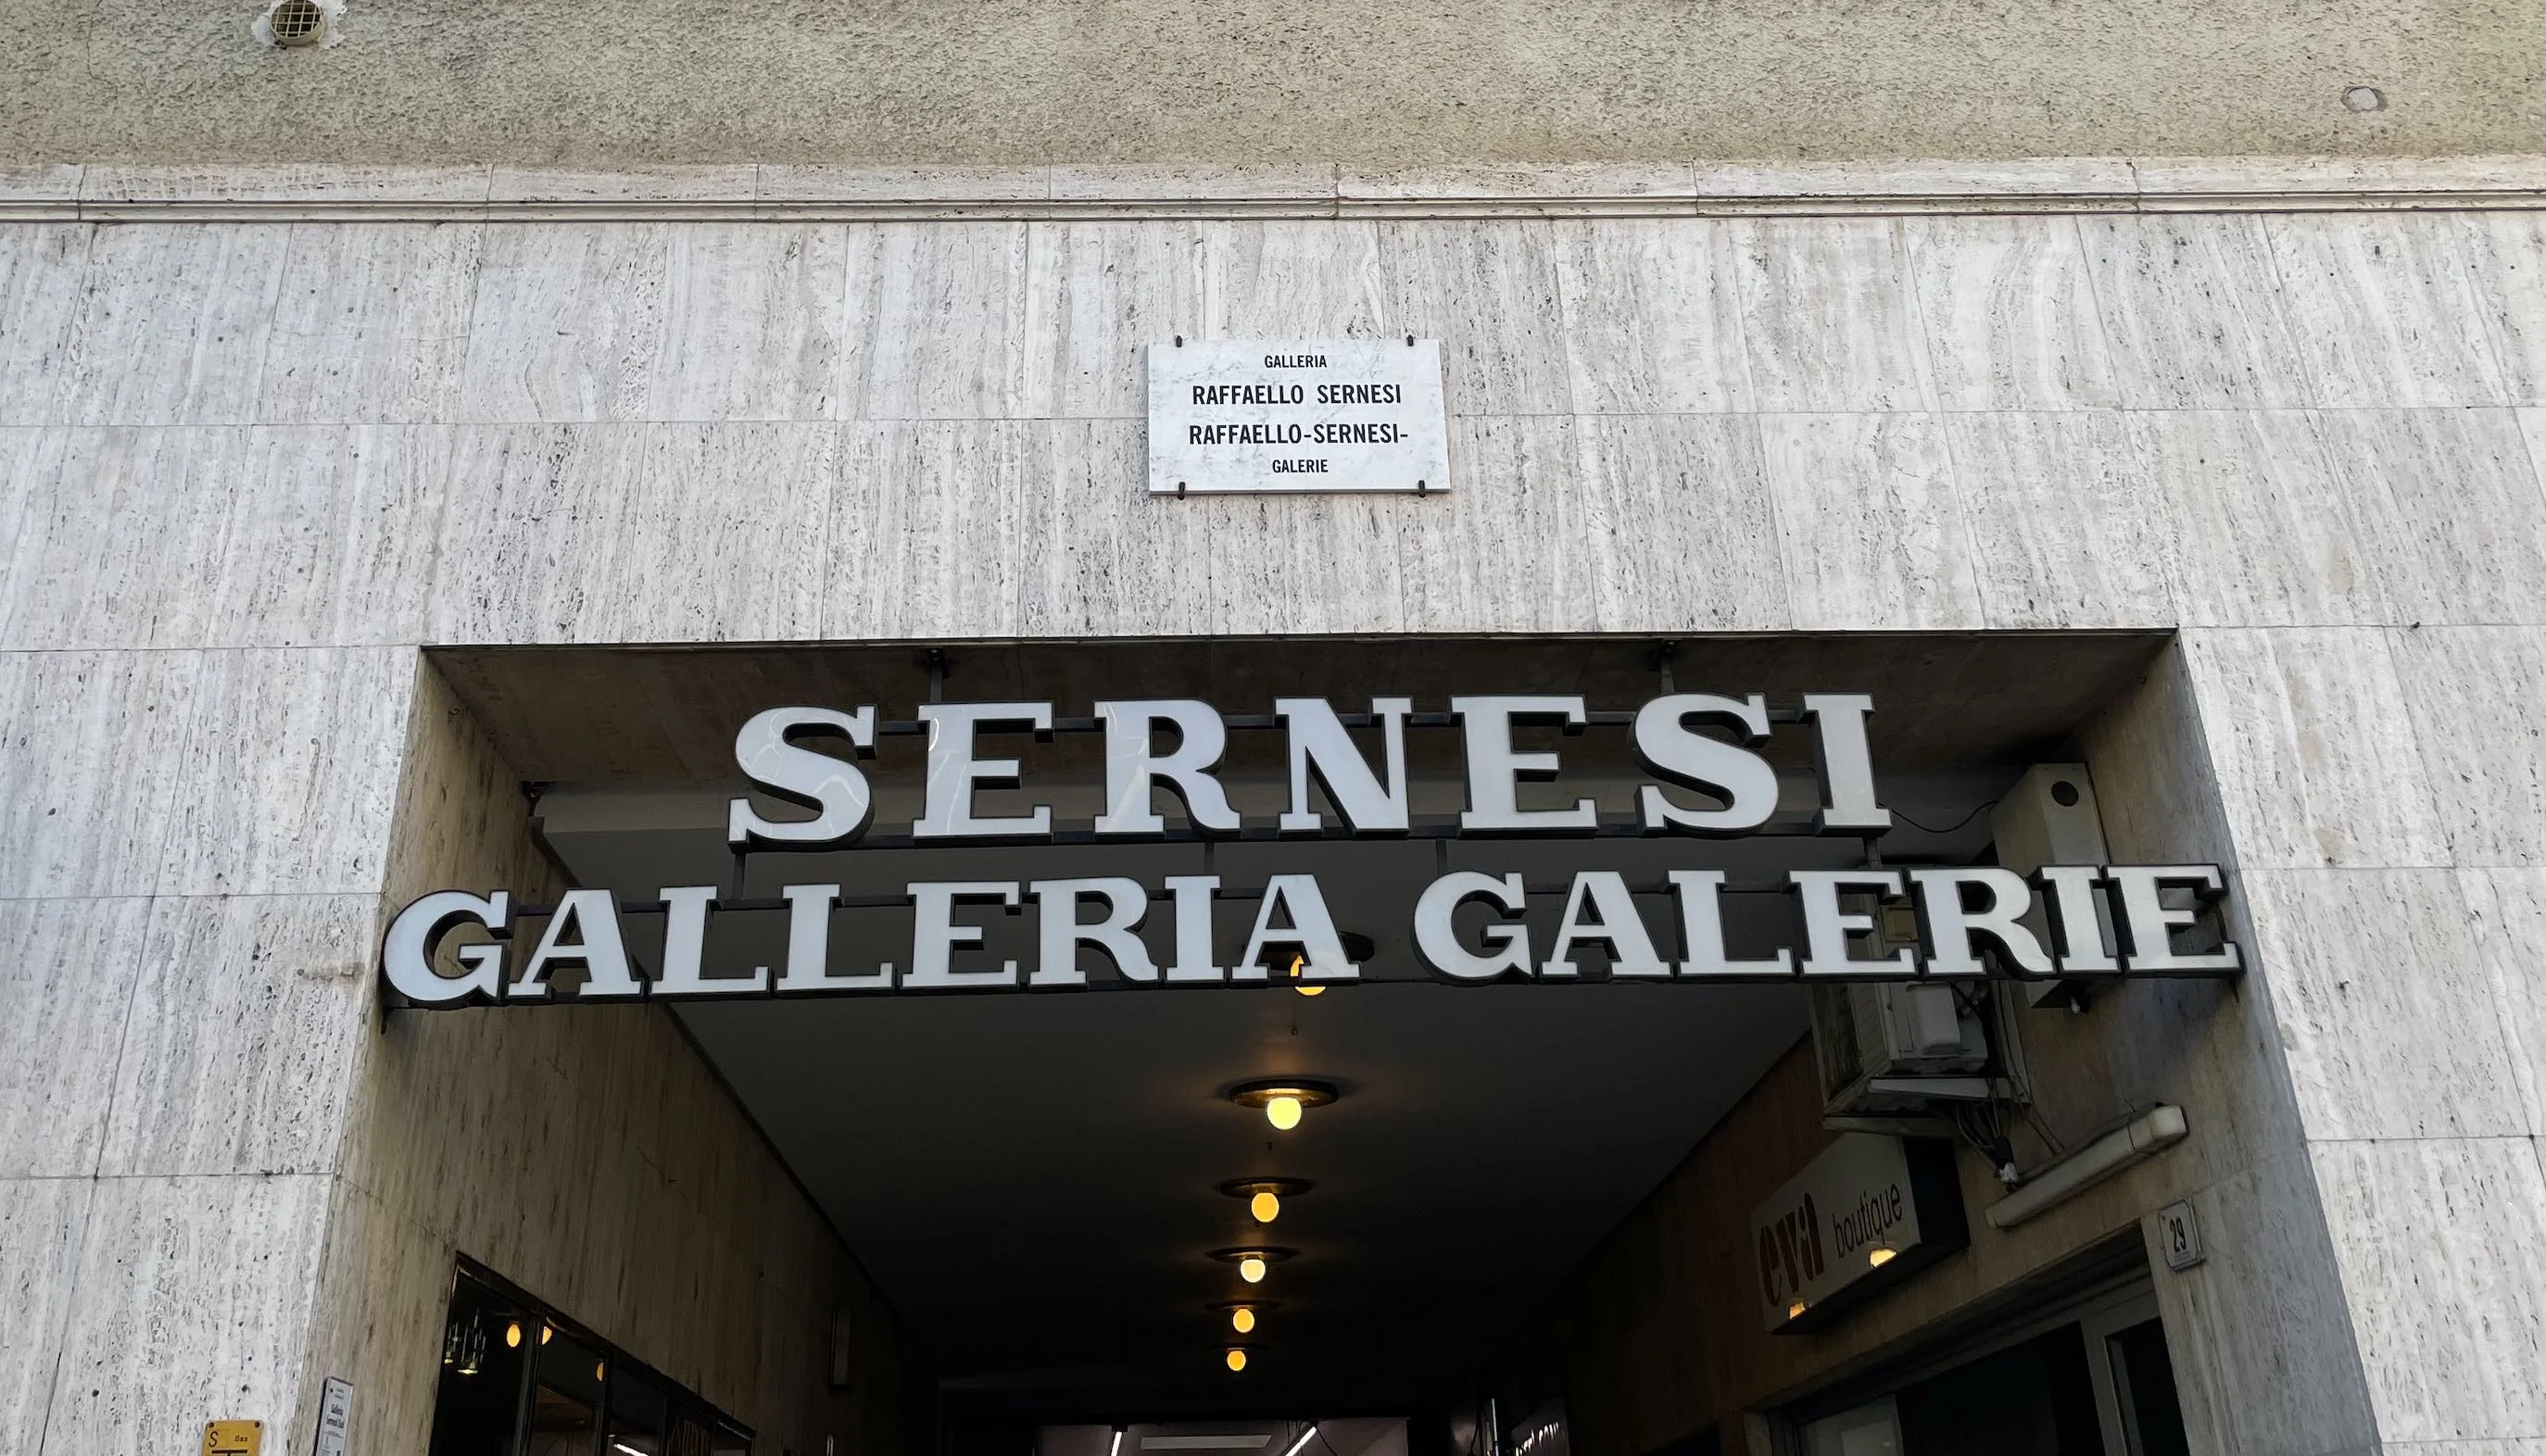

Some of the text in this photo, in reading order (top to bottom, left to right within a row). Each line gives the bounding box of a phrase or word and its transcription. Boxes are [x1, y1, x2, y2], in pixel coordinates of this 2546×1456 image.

[1264, 355, 1327, 368] GALLERIA
[1192, 383, 1401, 405] RAFFAELLO SERNESI
[1272, 459, 1329, 473] GALERIE
[727, 691, 1894, 847] SERNESI
[383, 863, 2243, 1004] GALLERIA GALERIE
[1832, 1183, 1903, 1259] boutique
[2169, 1216, 2187, 1253] 29
[208, 1430, 219, 1448] S
